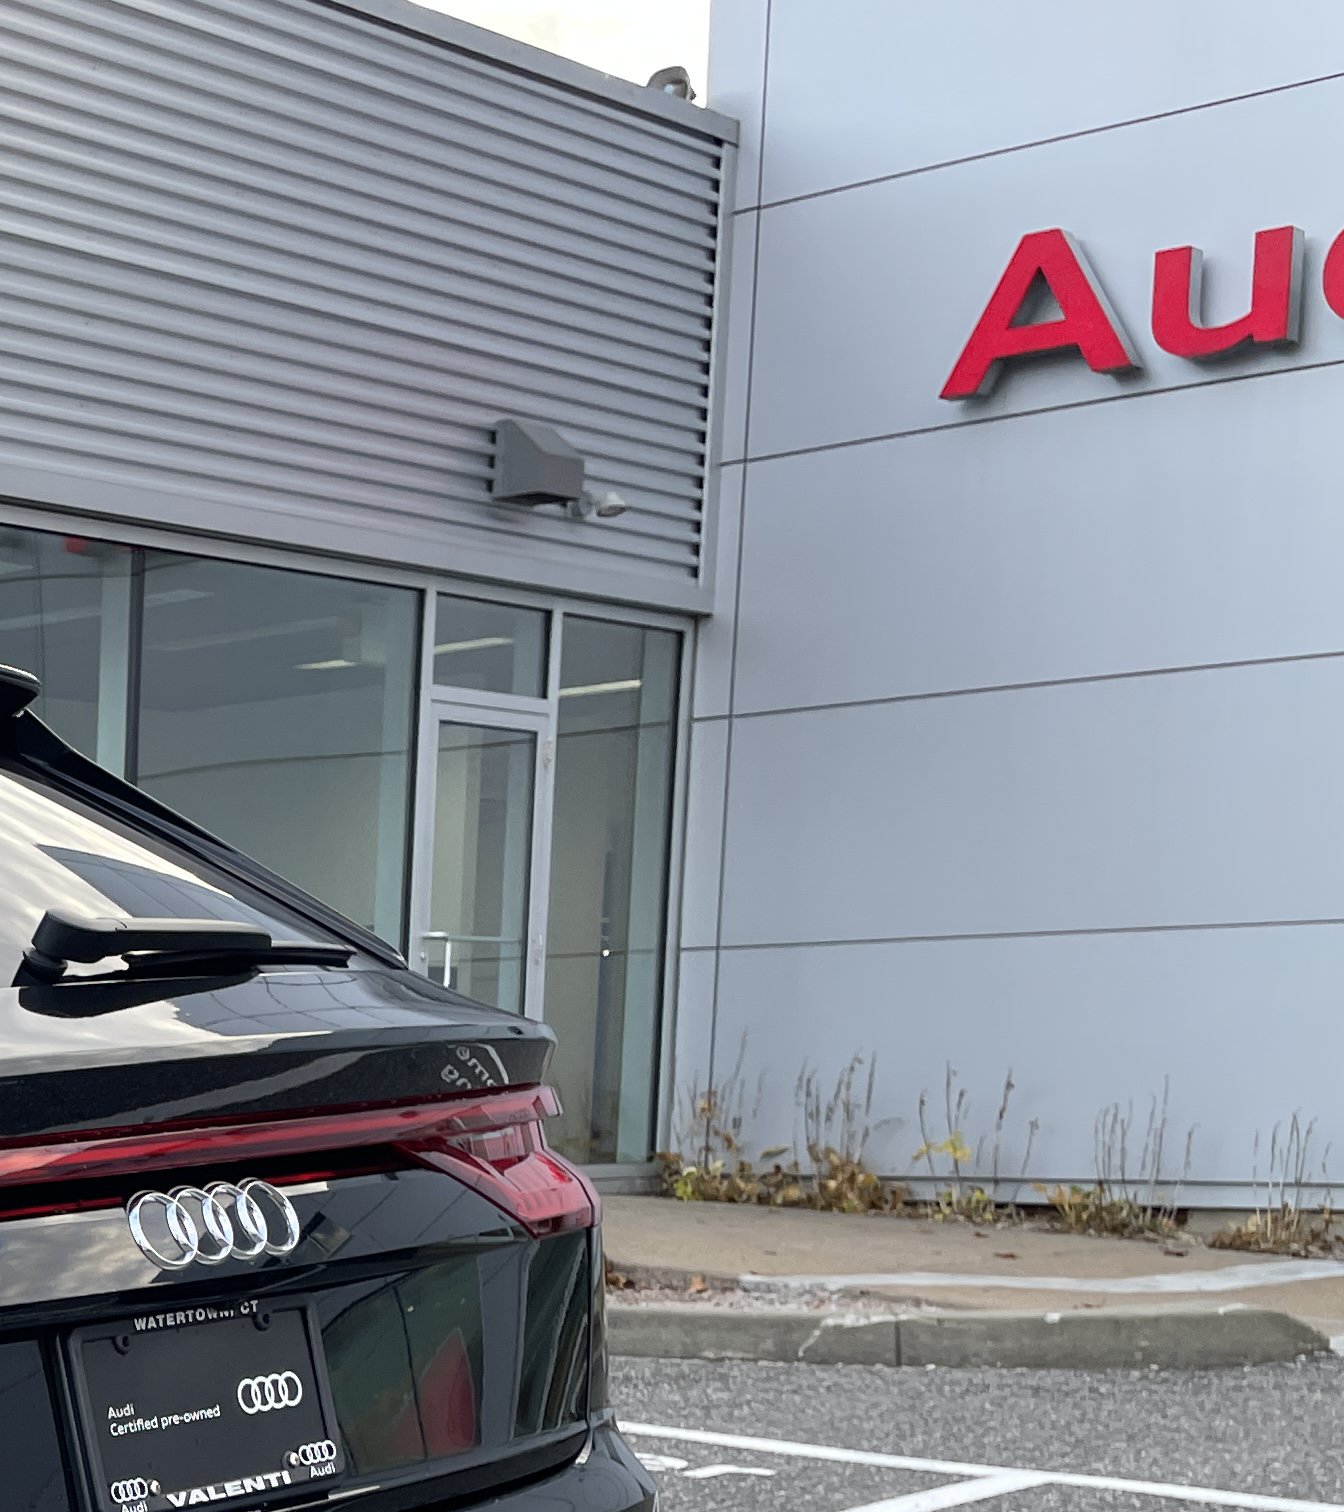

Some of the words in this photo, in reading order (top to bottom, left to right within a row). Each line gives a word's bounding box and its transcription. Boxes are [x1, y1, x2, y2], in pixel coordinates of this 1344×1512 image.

[939, 224, 1344, 402] Au
[240, 1300, 258, 1314] CT
[108, 1403, 134, 1419] Audi
[110, 1416, 158, 1436] Certified
[161, 1404, 221, 1430] pre-owned
[310, 1462, 336, 1478] Audi
[167, 1470, 292, 1507] VALENTI
